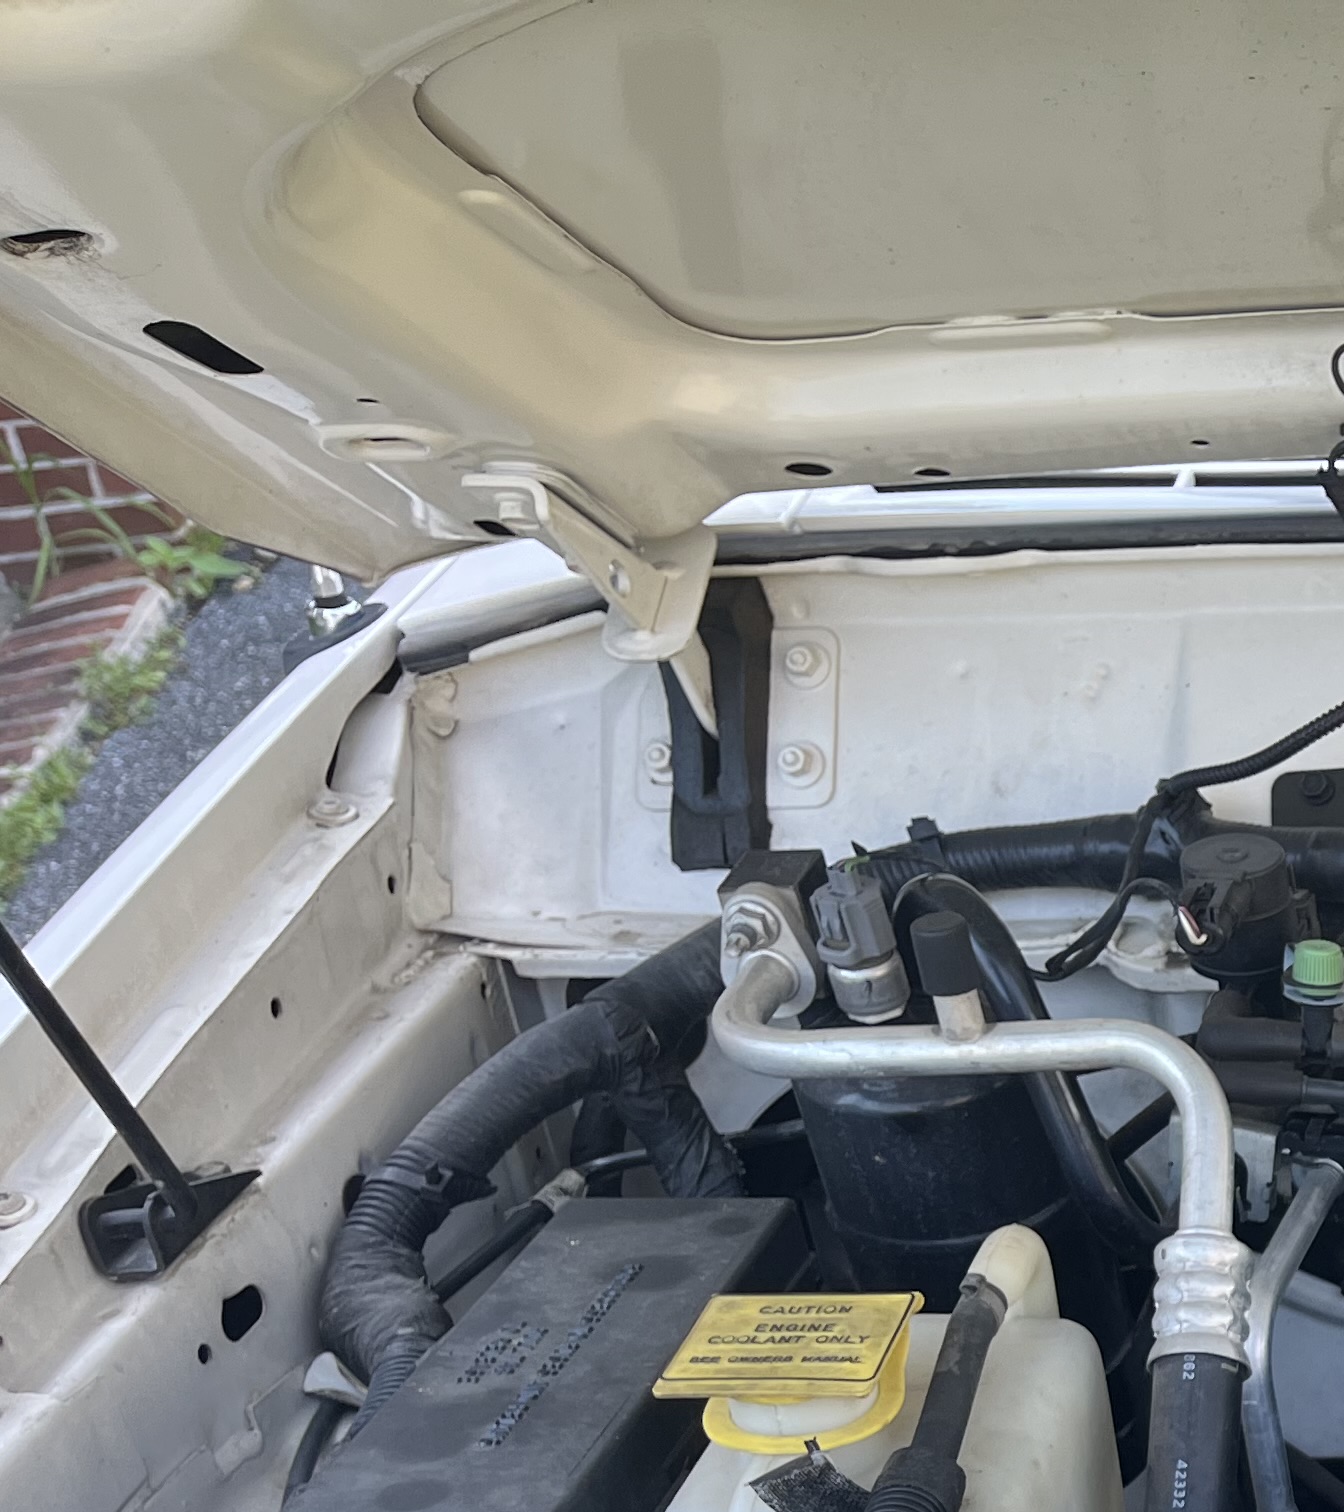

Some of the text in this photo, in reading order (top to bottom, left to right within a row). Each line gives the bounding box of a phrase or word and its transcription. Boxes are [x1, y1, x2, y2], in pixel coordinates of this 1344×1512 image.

[759, 1304, 854, 1316] CAUTION
[754, 1322, 838, 1334] ENGINE
[707, 1334, 871, 1345] COOLANT ONLY
[1171, 1458, 1188, 1510] 42332
